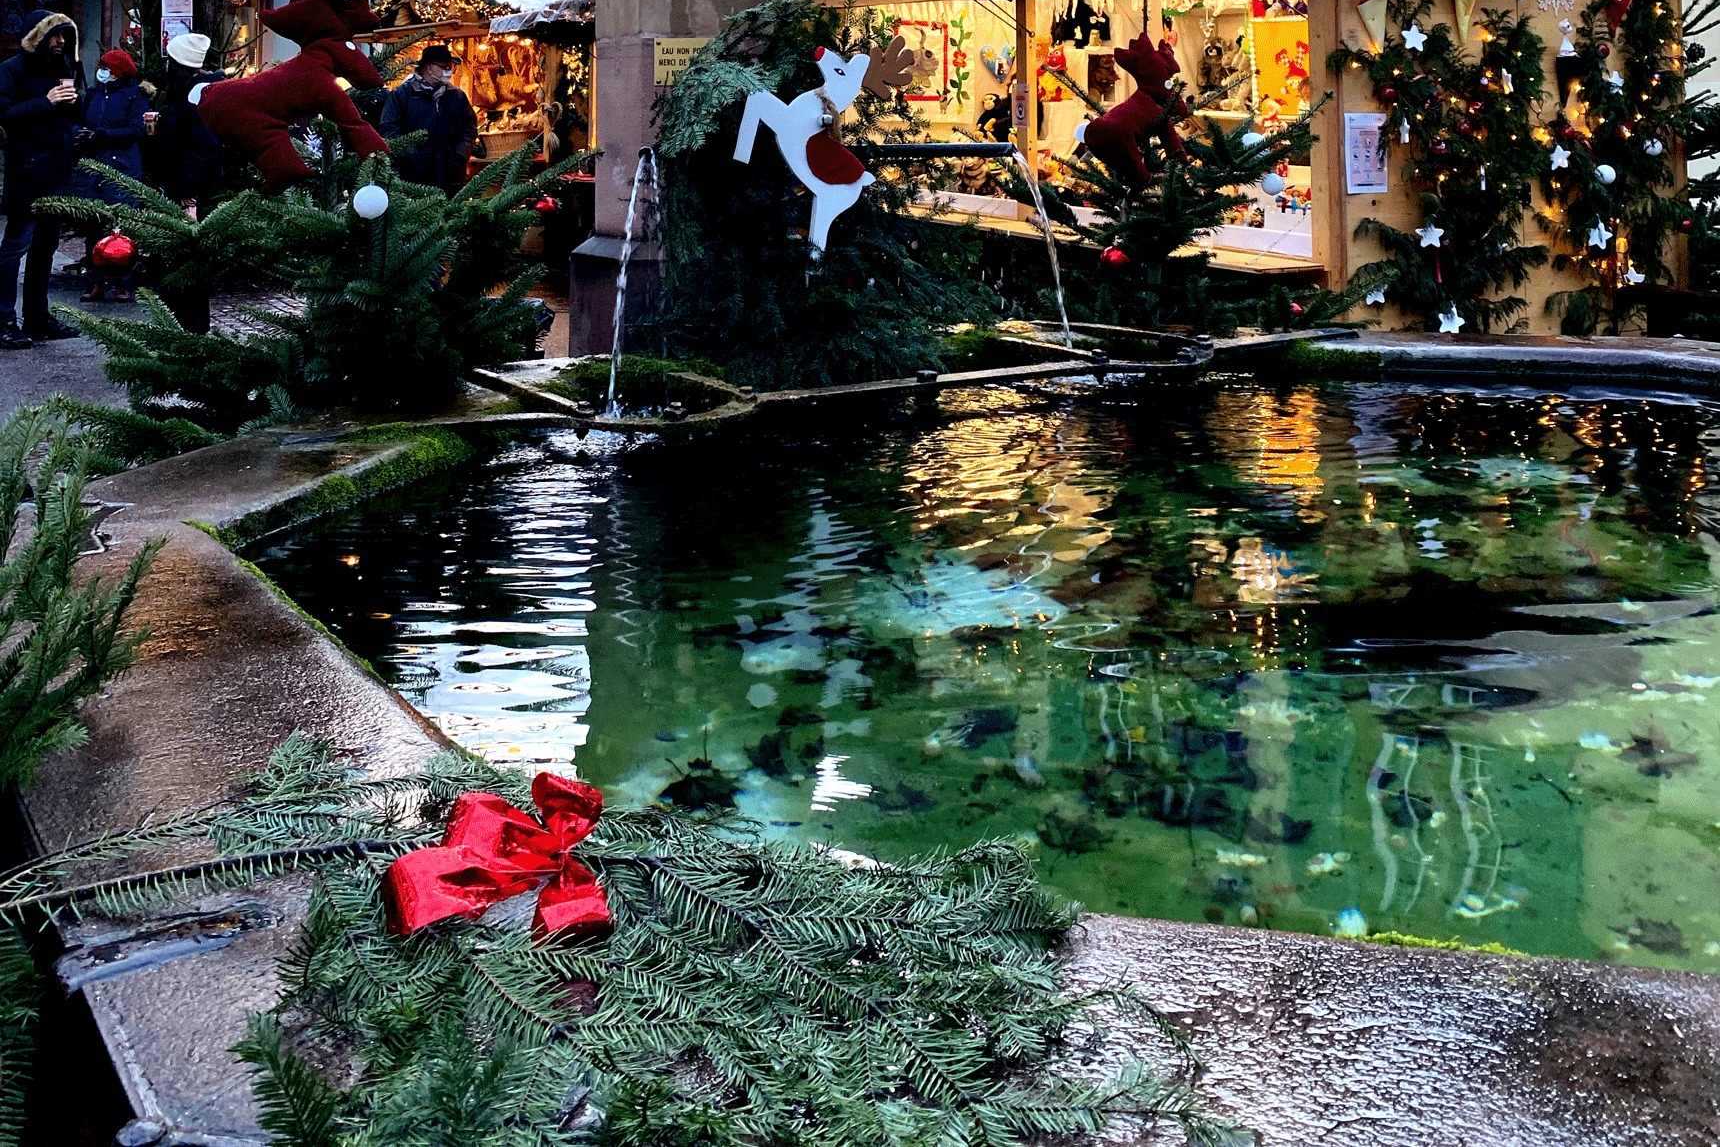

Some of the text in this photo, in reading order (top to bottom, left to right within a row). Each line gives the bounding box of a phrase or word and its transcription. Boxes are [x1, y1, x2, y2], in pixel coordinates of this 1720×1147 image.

[662, 47, 718, 55] EAU NON POLE
[659, 58, 676, 66] MERCI
[679, 58, 687, 66] DE
